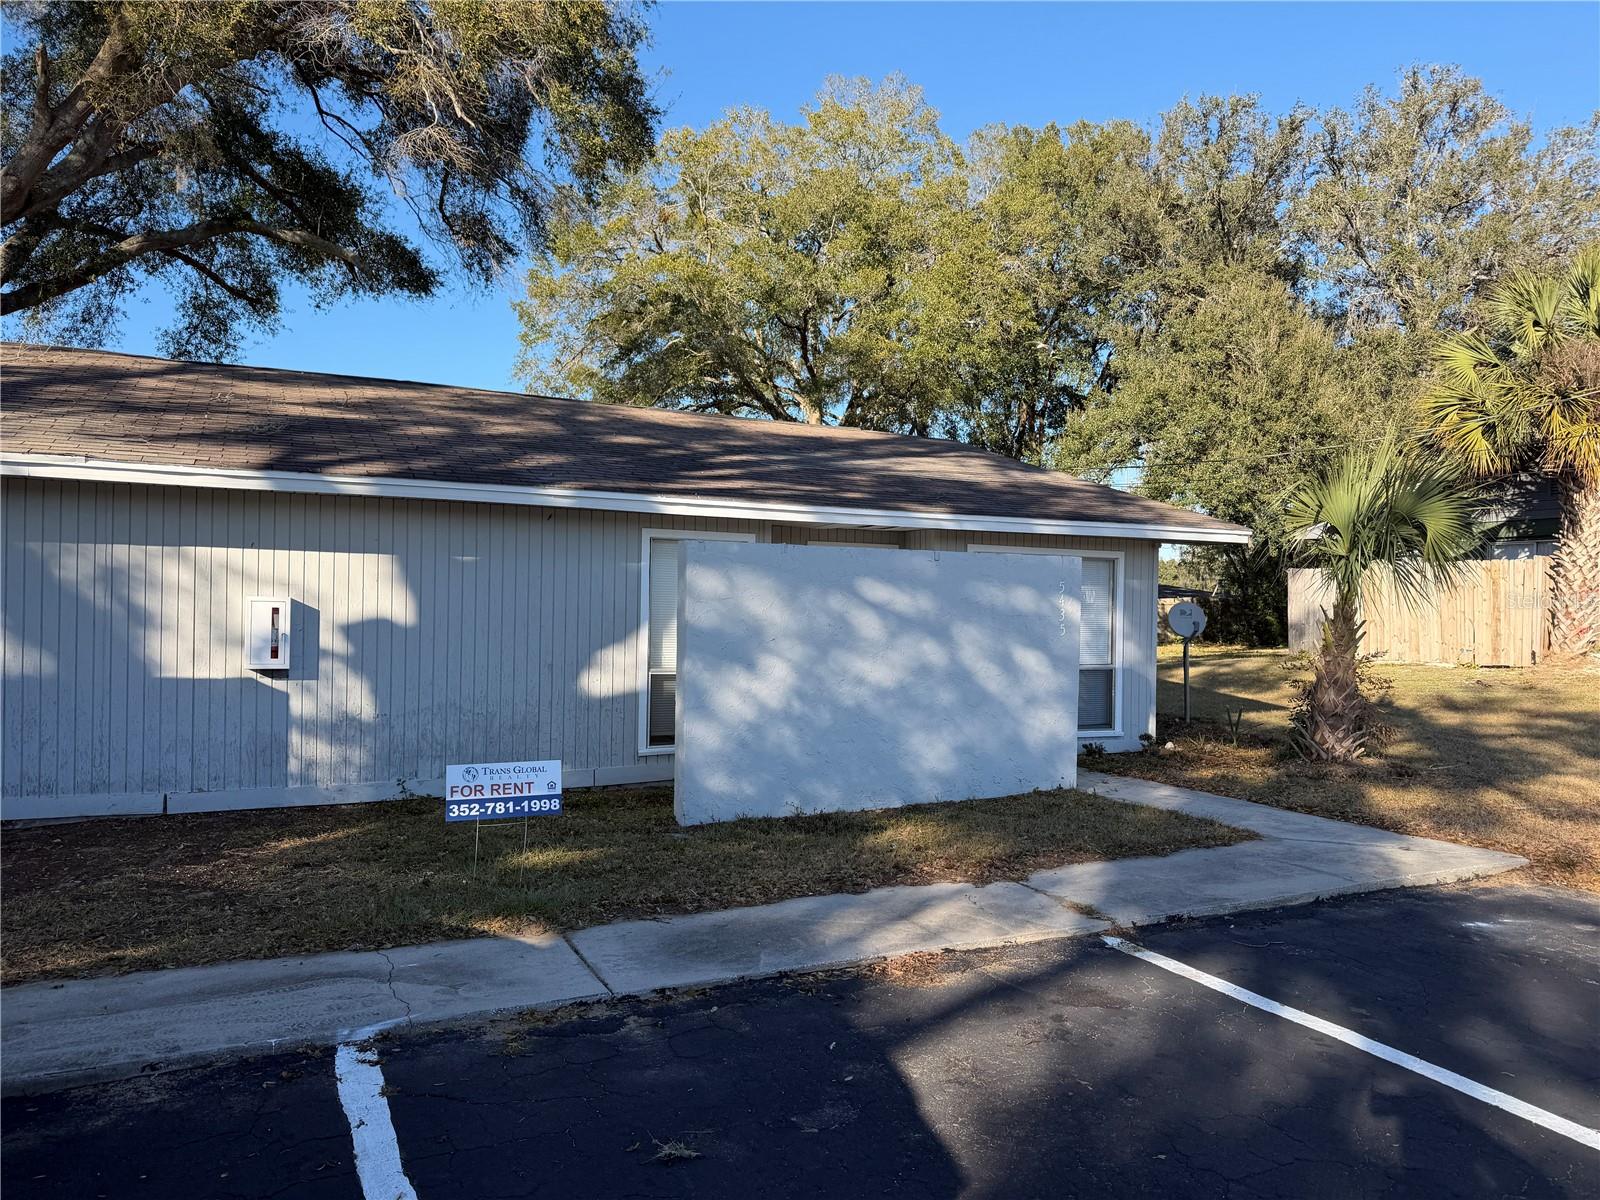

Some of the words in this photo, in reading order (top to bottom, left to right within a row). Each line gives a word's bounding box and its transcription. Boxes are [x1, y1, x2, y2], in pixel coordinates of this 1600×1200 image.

[1058, 582, 1066, 636] 5435
[481, 767, 511, 775] TRANS
[513, 765, 547, 774] GLOBAL
[450, 784, 485, 798] FOR
[490, 782, 534, 796] RENT
[449, 798, 560, 817] 352-781-1998
